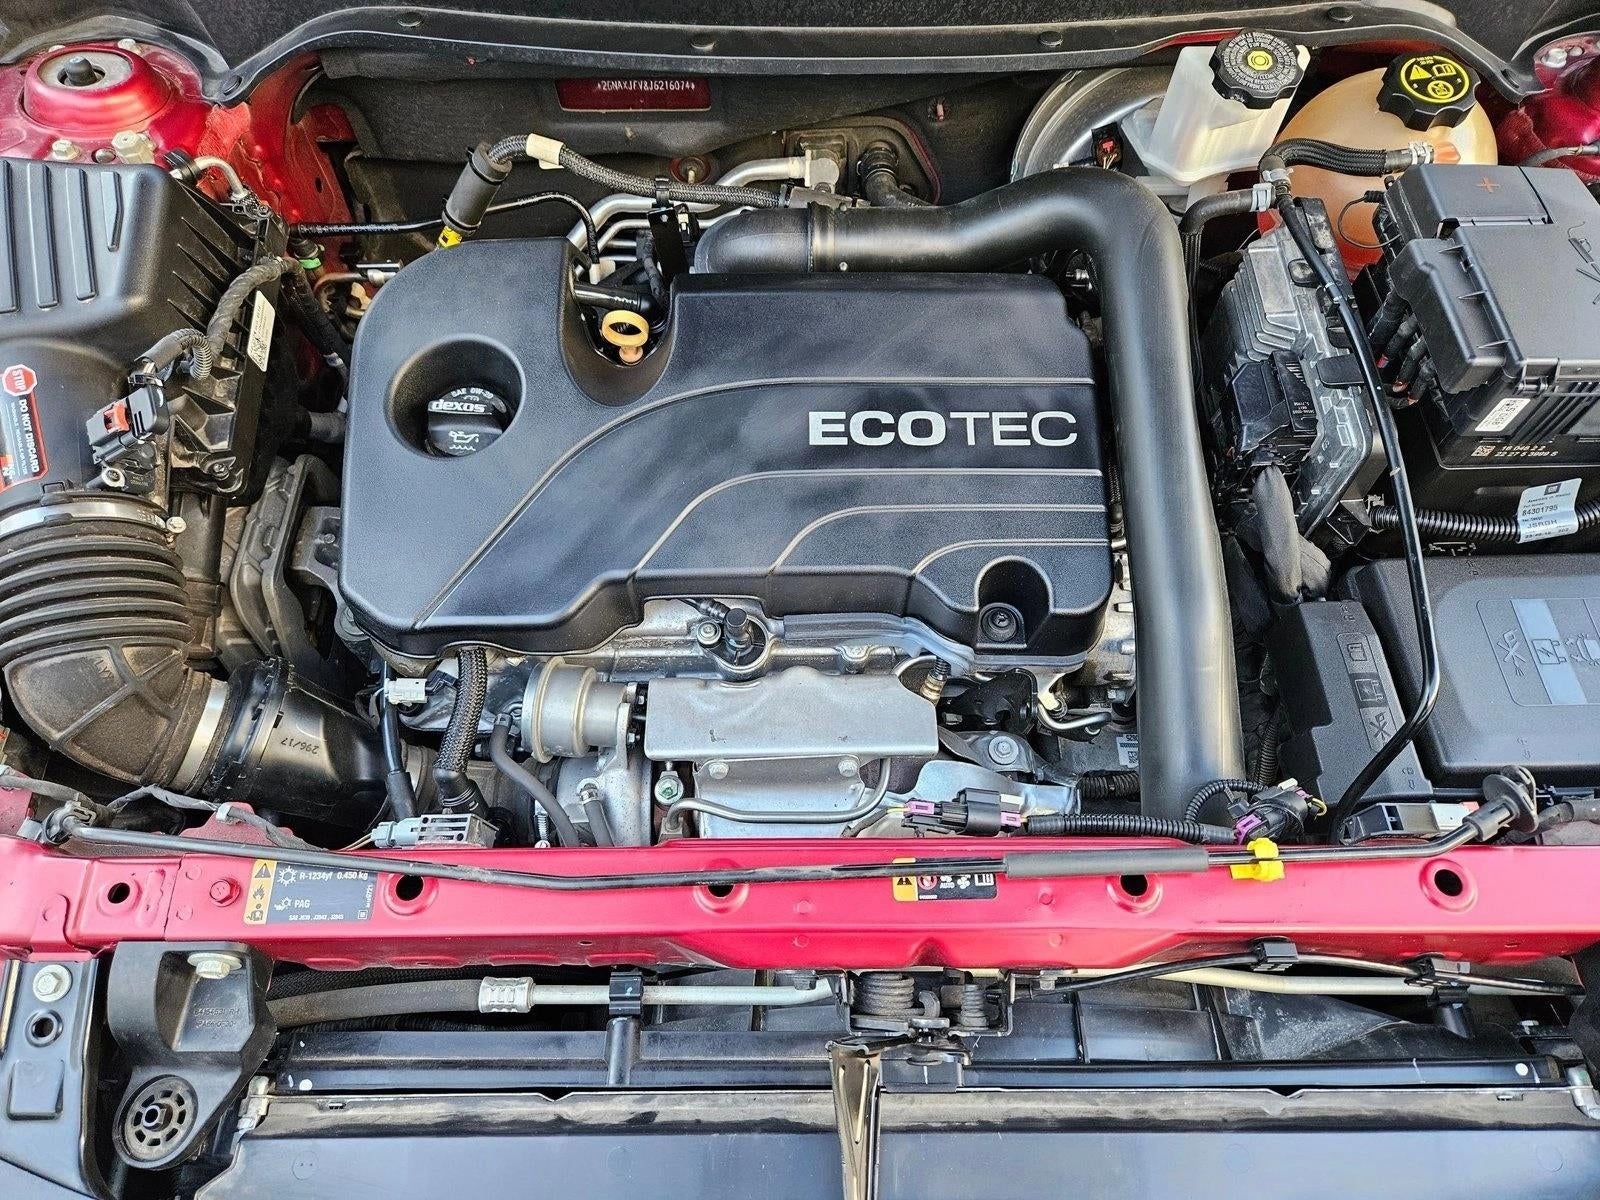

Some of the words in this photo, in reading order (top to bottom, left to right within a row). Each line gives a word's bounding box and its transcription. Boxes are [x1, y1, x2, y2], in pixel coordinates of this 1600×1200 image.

[12, 368, 27, 392] STOP
[20, 398, 28, 413] DO
[431, 399, 487, 413] dexos
[22, 413, 32, 432] NOT
[808, 411, 1077, 447] ECOTEC
[25, 433, 40, 474] DISCARD
[1522, 504, 1558, 517] 84301795
[299, 871, 332, 882] R-1234yf
[337, 870, 358, 880] 0.450
[358, 871, 369, 881] kg
[294, 899, 311, 909] PAG
